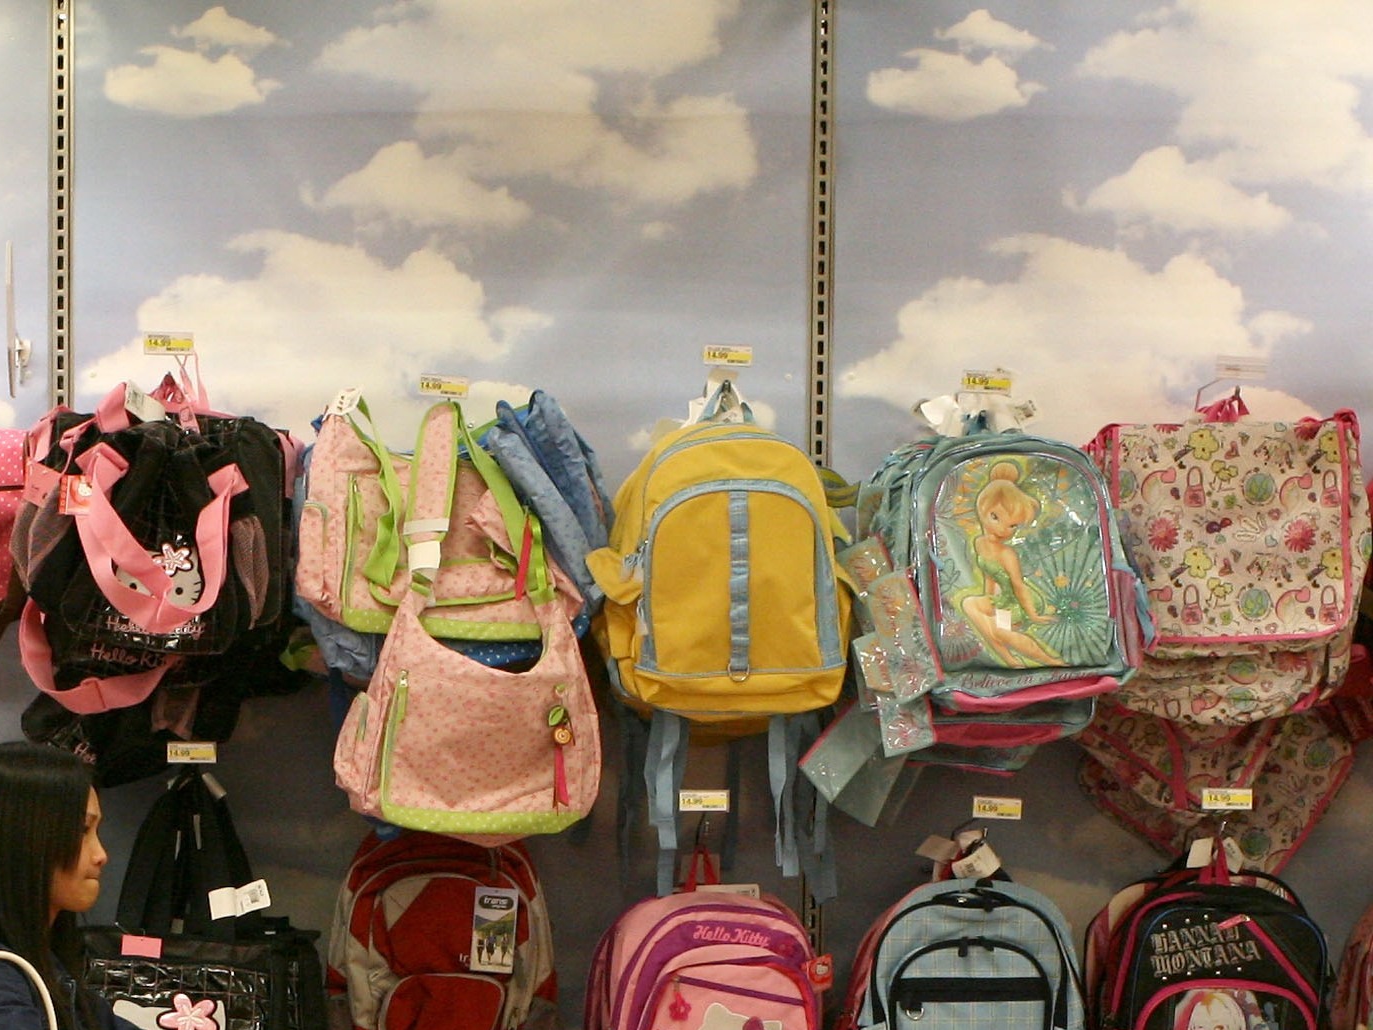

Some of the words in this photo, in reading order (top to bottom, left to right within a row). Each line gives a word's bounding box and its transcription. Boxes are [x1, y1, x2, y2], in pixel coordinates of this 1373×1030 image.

[693, 925, 730, 942] Hello
[730, 927, 770, 947] Kitty
[1149, 940, 1262, 978] MONTANA
